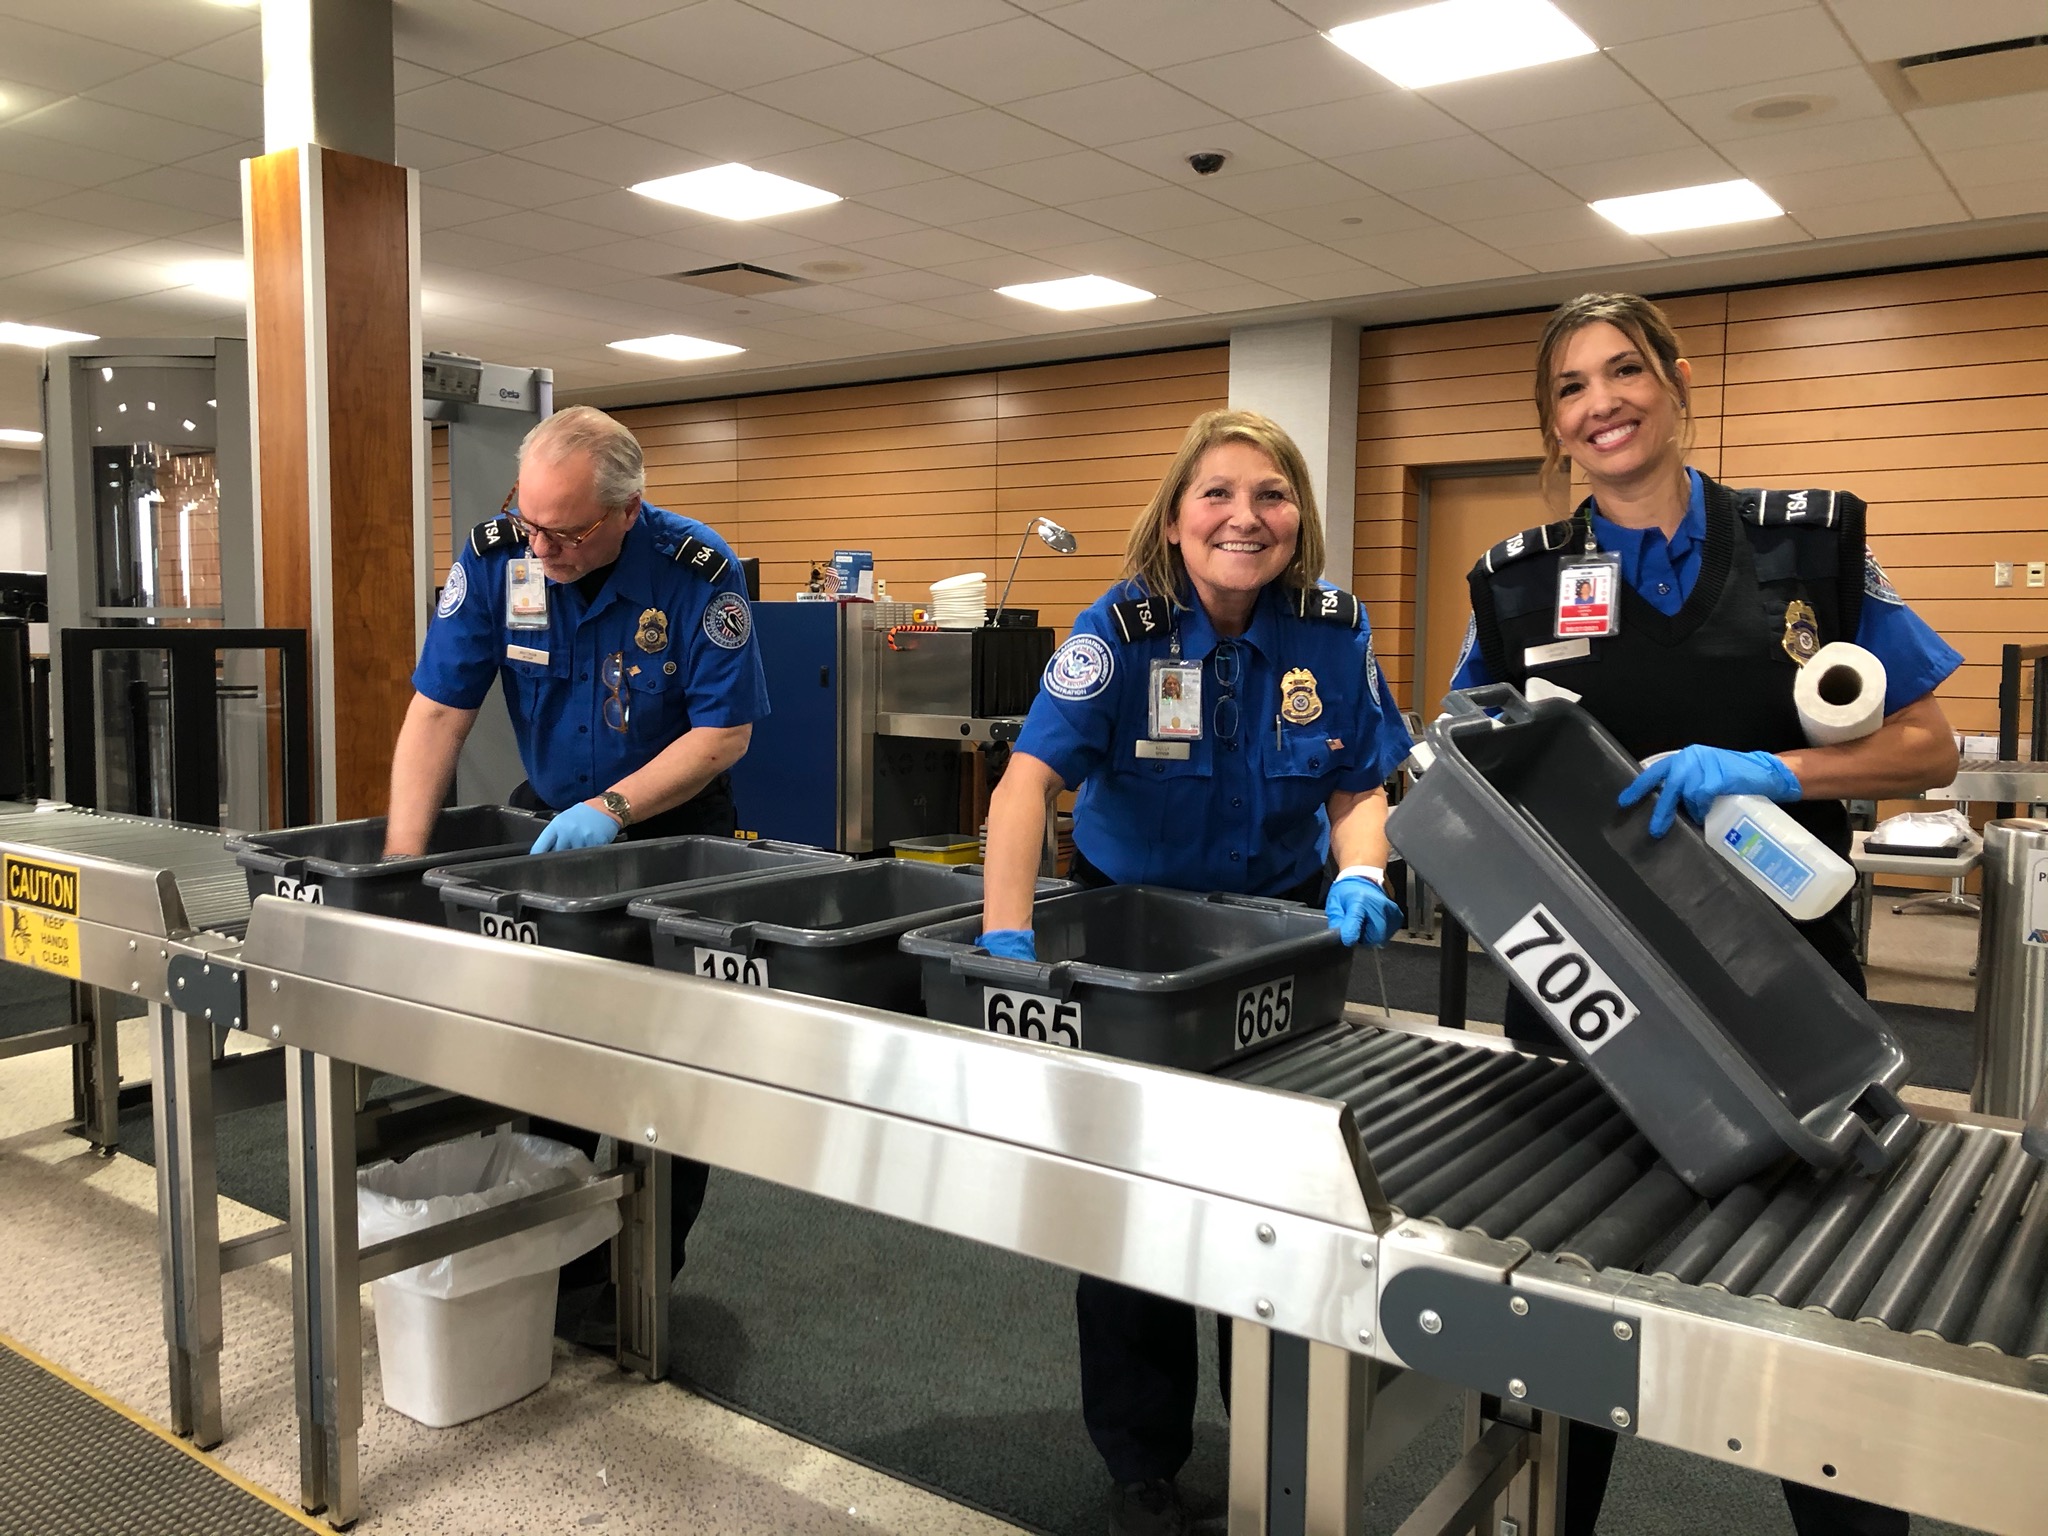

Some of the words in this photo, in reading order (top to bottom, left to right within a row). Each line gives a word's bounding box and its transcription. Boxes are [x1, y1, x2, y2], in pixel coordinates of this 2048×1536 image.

[1785, 490, 1808, 522] TSA
[484, 519, 501, 545] TSA
[1506, 532, 1526, 557] TSA
[691, 546, 715, 567] TSA
[1136, 599, 1156, 632] TSA
[1321, 589, 1338, 616] TSA
[10, 864, 74, 910] CAUTION
[2039, 872, 2048, 882] P
[43, 914, 65, 930] KEEP
[41, 932, 69, 951] HANDS
[42, 950, 70, 968] CLEAR
[1505, 910, 1626, 1042] 706
[988, 993, 1079, 1048] 665
[1238, 981, 1292, 1046] 665
